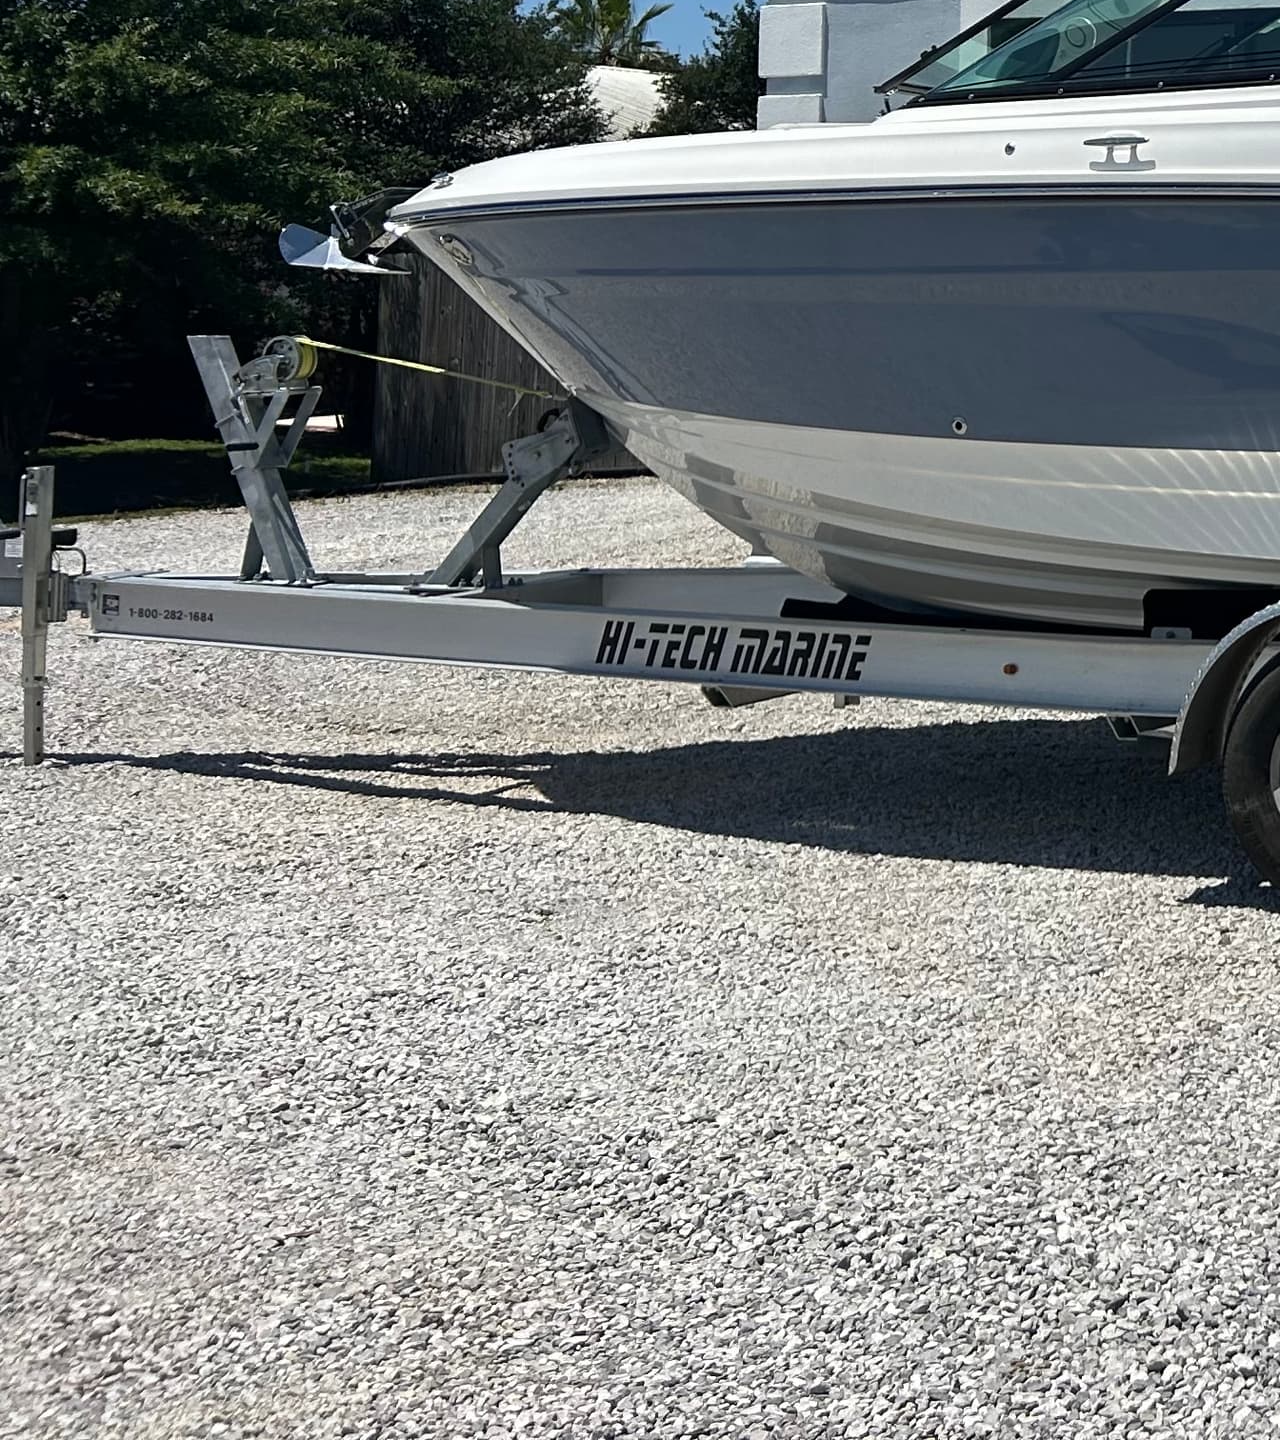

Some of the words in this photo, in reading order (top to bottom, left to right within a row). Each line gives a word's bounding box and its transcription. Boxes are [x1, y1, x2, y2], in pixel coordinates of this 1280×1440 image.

[128, 607, 215, 623] 1-800-282-1684
[595, 620, 729, 672] HI-TECH
[729, 627, 873, 681] MARINE
